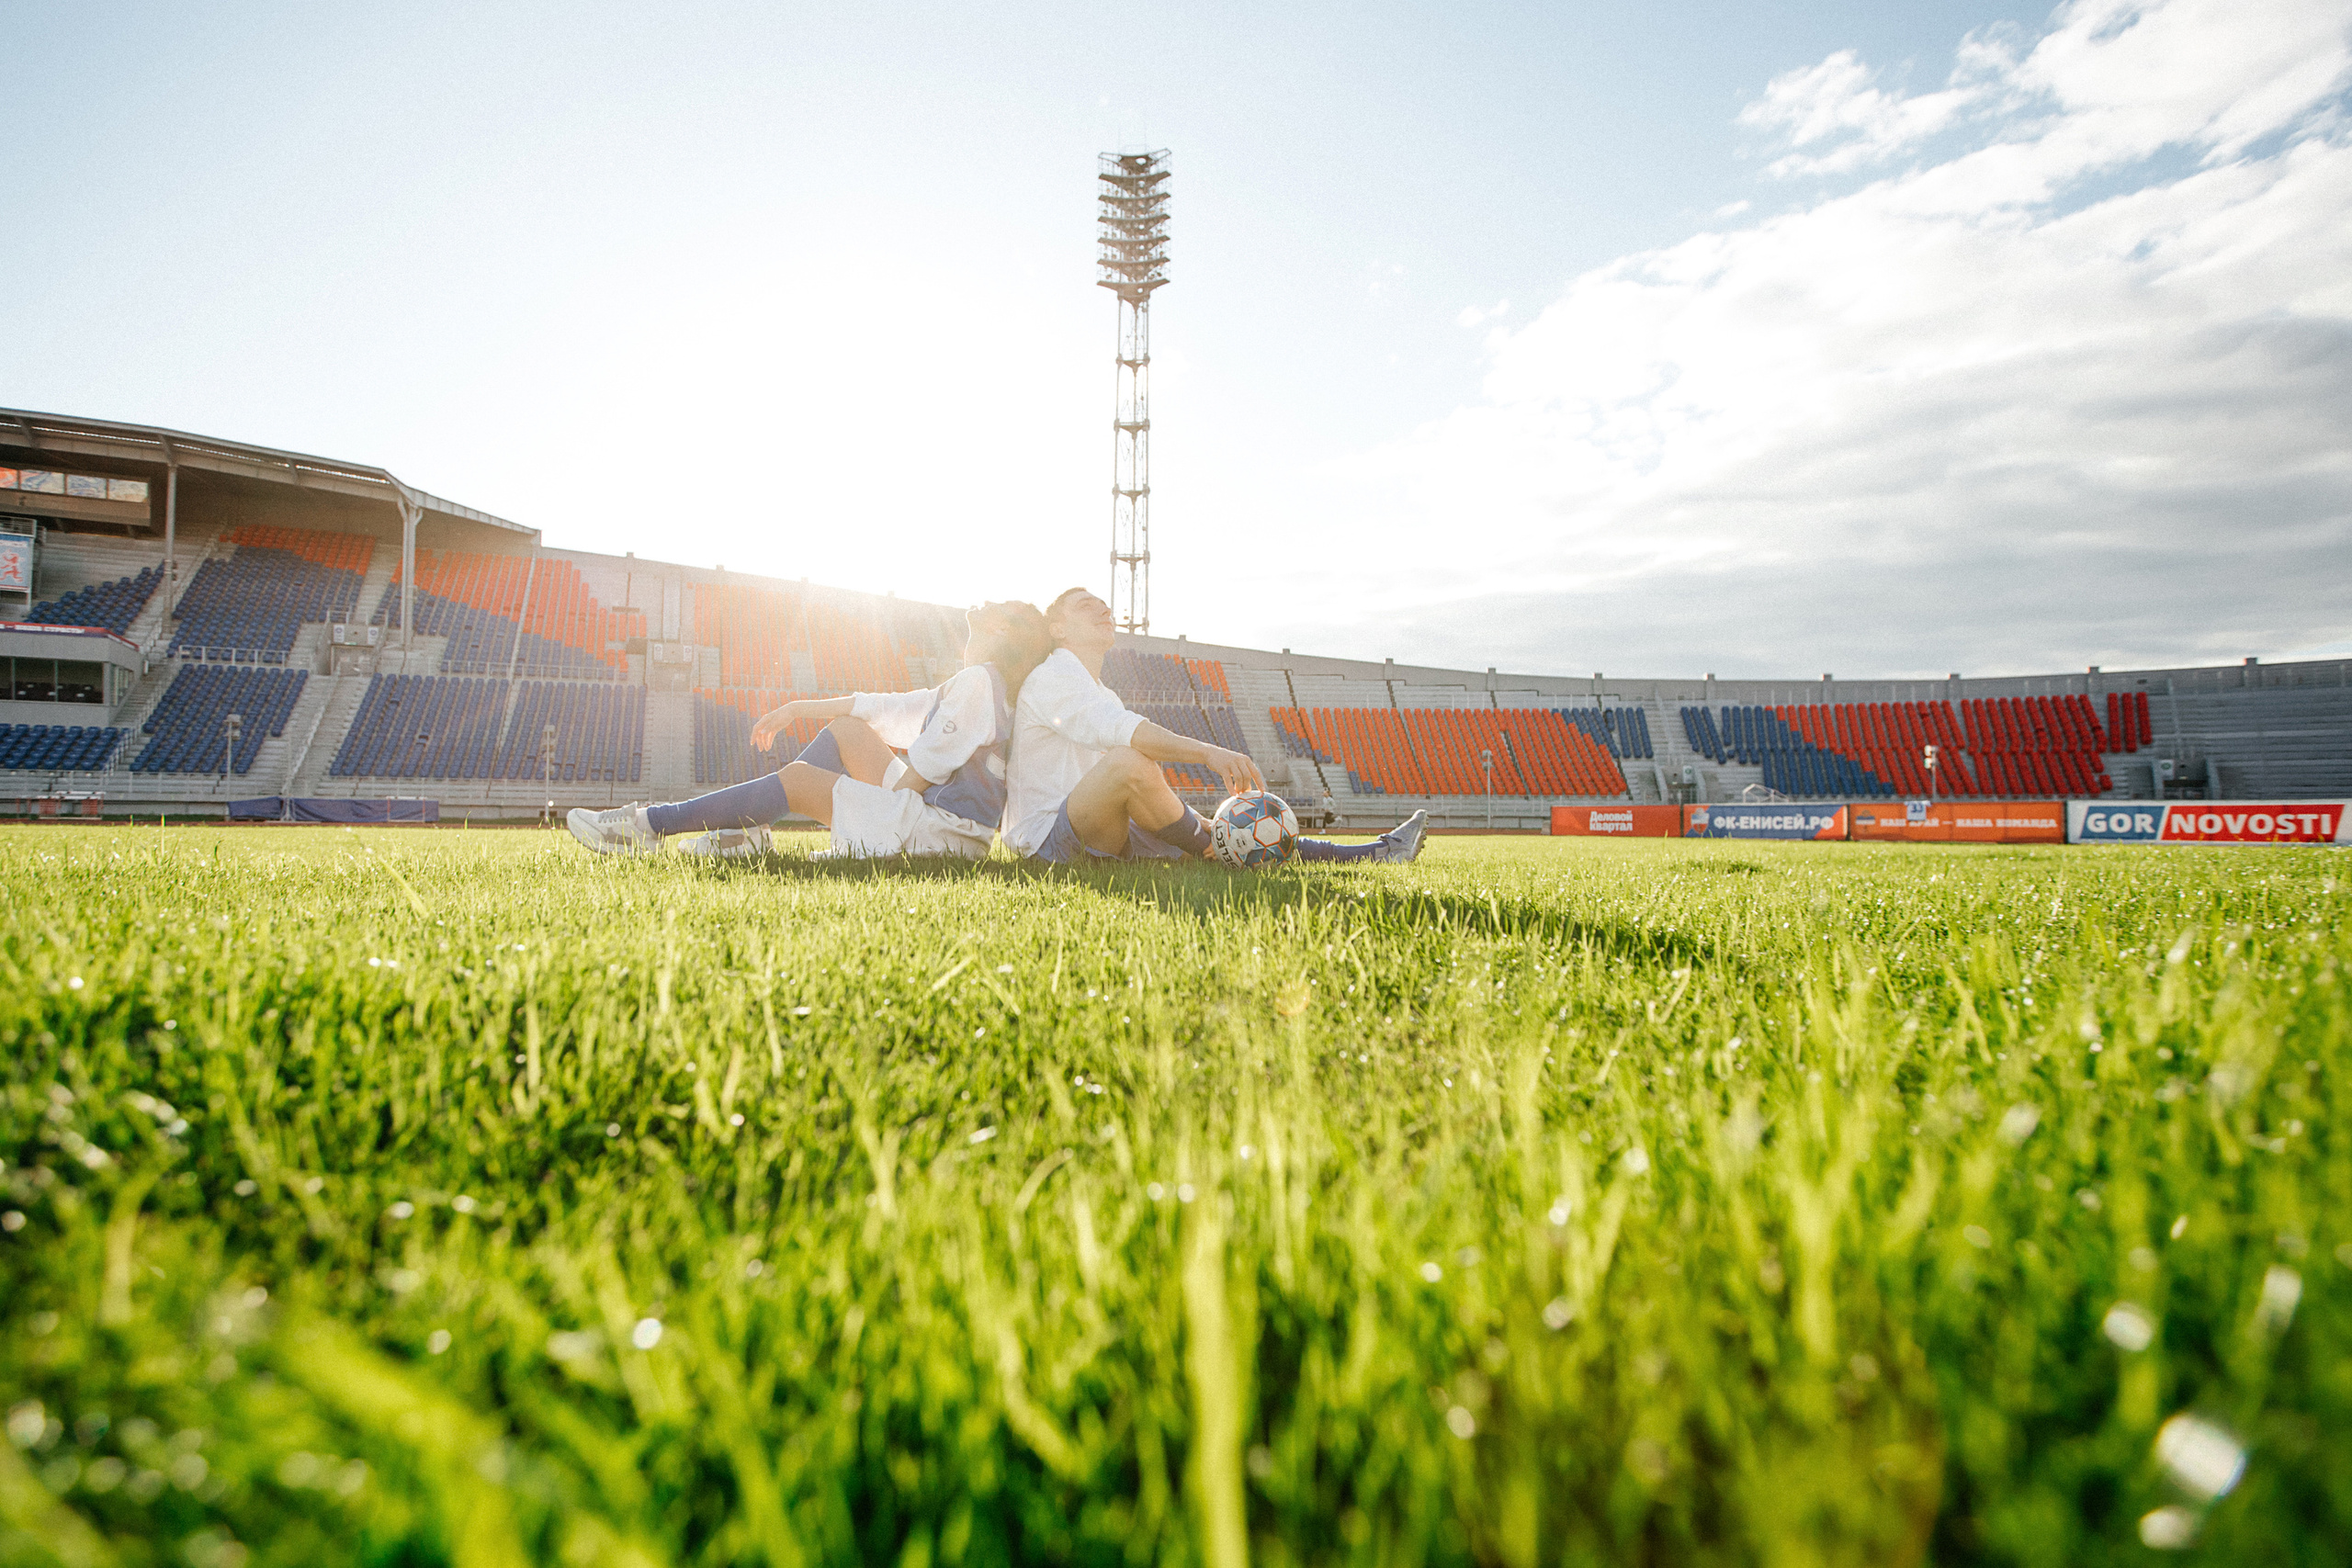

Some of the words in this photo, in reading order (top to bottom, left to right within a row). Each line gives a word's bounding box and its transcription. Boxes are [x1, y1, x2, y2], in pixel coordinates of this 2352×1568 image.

[1590, 810, 1633, 821] Деловой
[1713, 814, 1835, 830] ФК-ЕНИСЕЙ.РФ
[2086, 813, 2155, 833] GOR
[2172, 814, 2331, 835] NOVOSTI
[1216, 826, 1239, 869] SELECT
